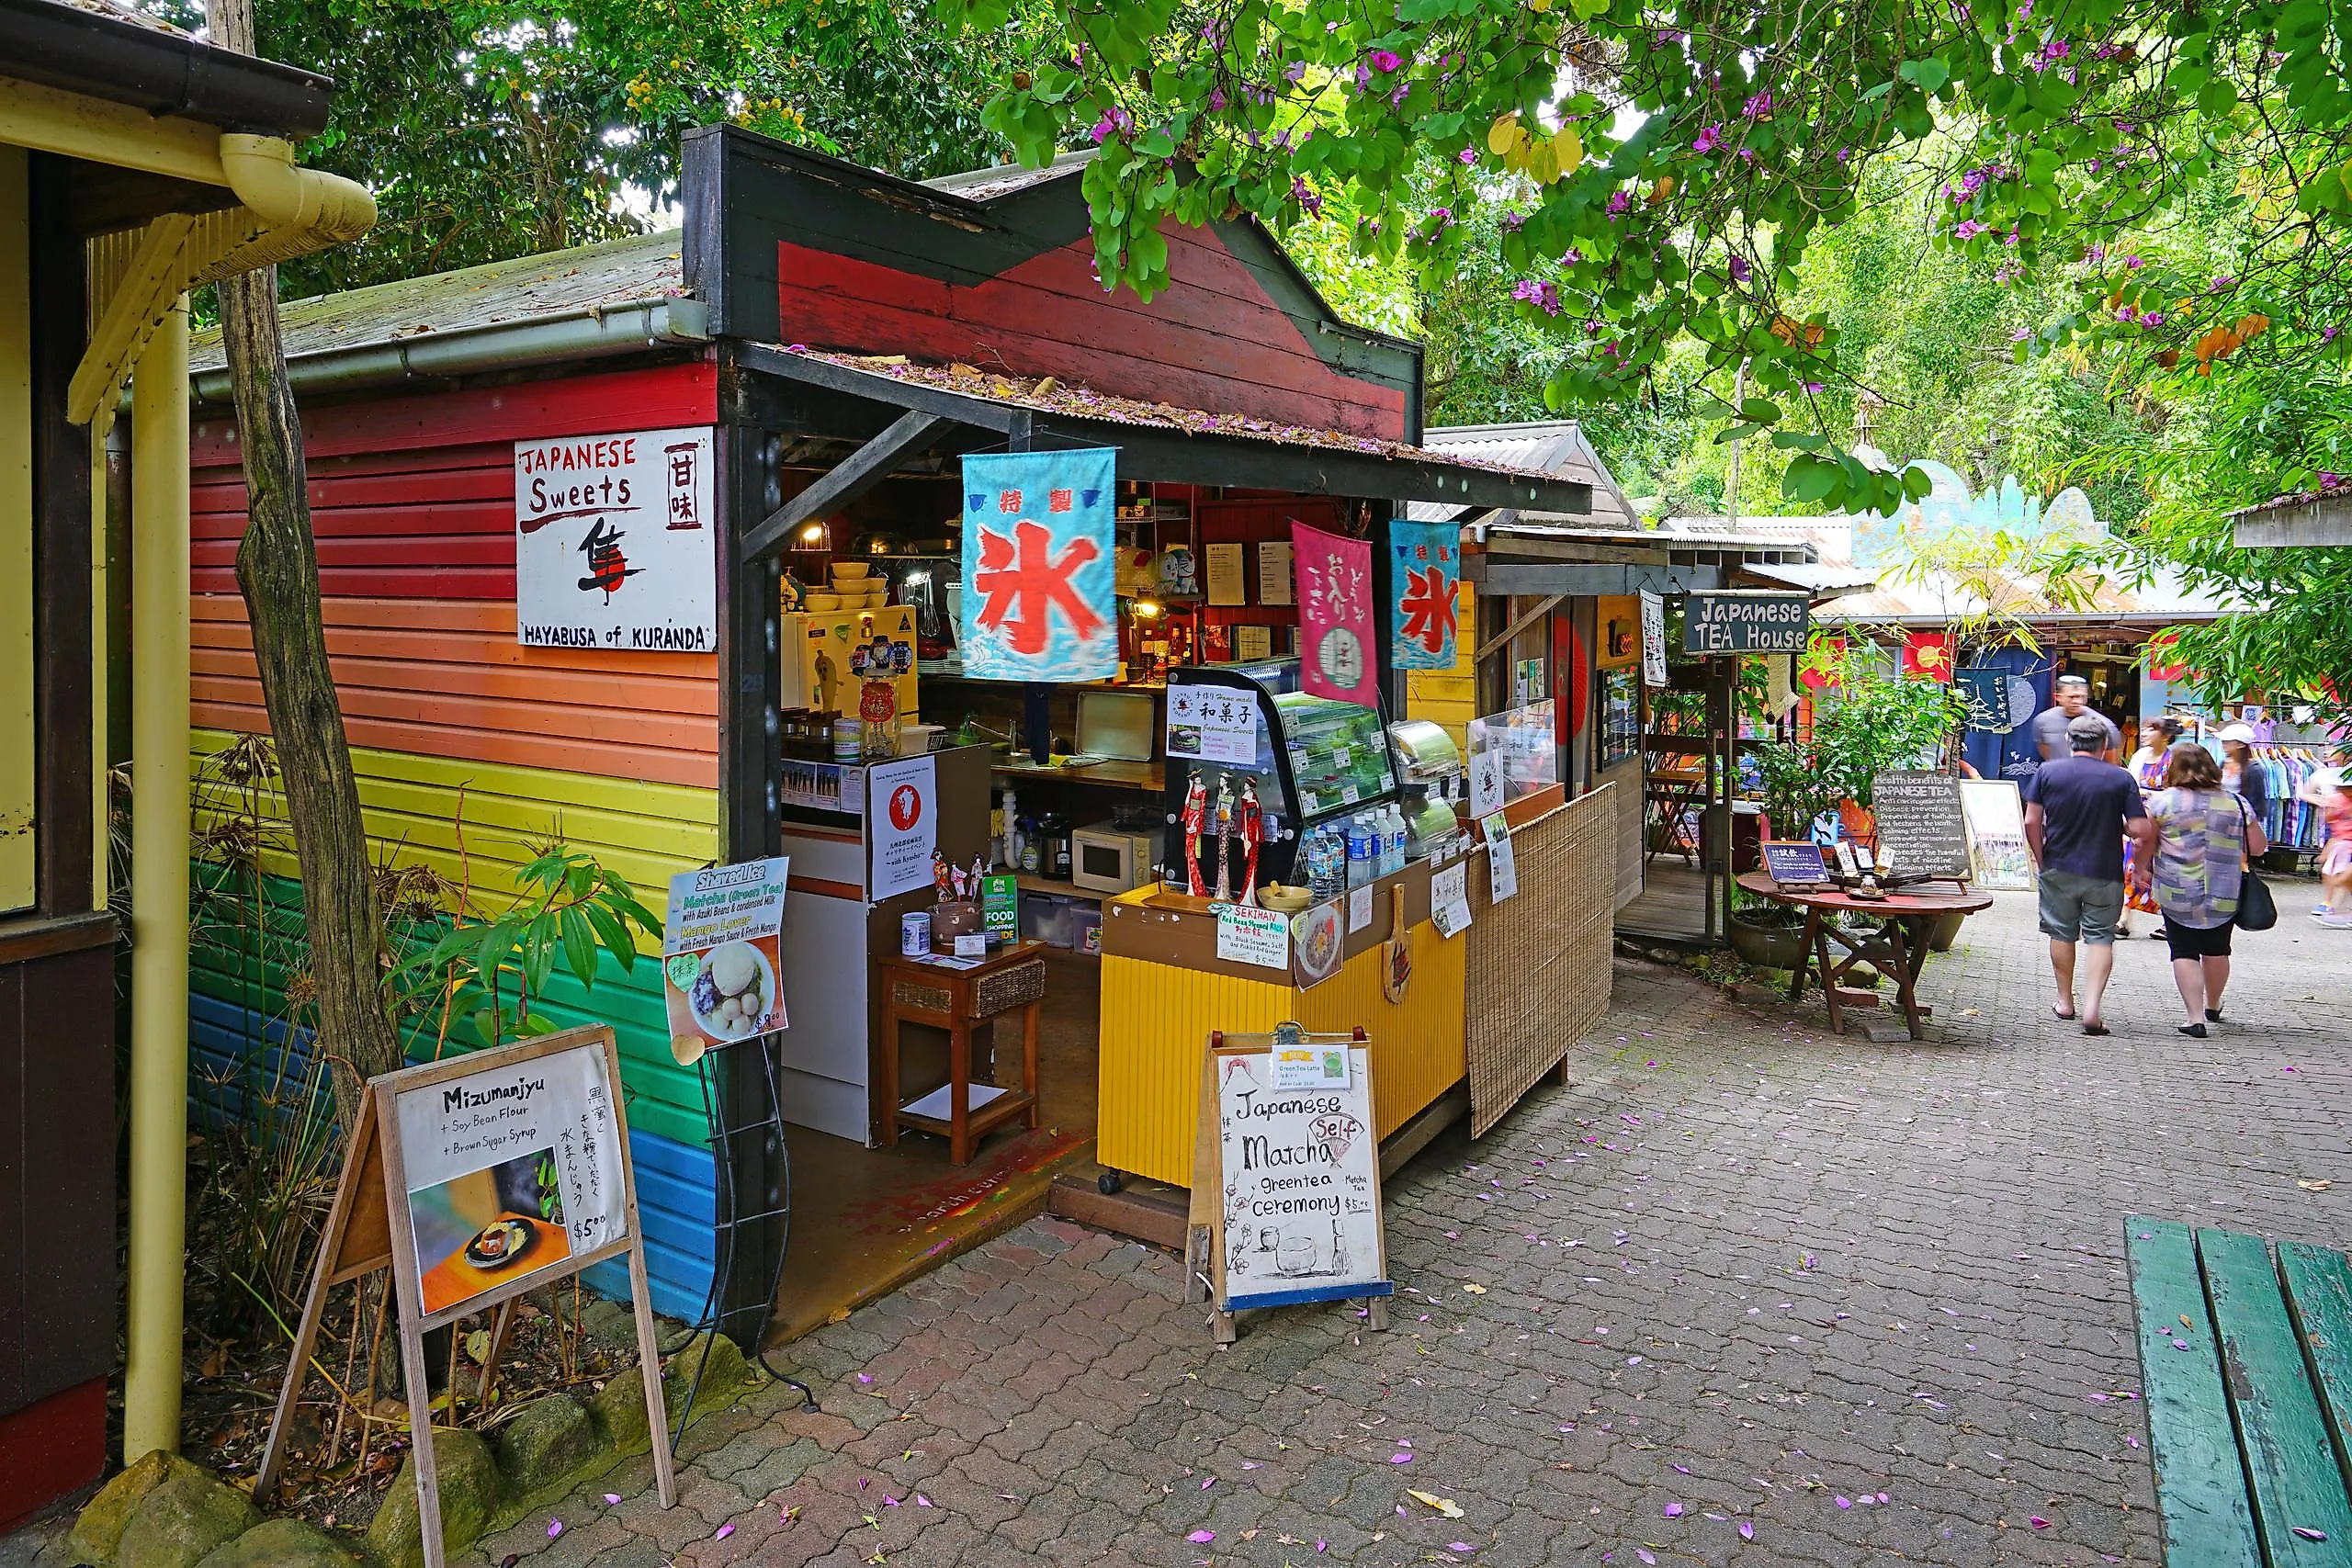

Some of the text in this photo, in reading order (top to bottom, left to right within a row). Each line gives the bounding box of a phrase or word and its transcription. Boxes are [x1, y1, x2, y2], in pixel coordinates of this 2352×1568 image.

[520, 438, 636, 474] JAPANESE
[529, 475, 631, 513] Sweets
[672, 456, 693, 520] 甘味
[1000, 489, 1073, 513] 特製
[976, 521, 1104, 655] 氷
[1400, 565, 1459, 653] 氷
[1701, 597, 1802, 624] Japanese
[524, 626, 706, 649] HAYABUSA of KURANDA
[1694, 623, 1806, 649] TEA House
[1199, 702, 1251, 724] 和菓子
[1874, 774, 1953, 784] Health benefits of
[1874, 785, 1952, 796] JAPANESE TEA
[697, 864, 766, 888] Shaved Ice
[684, 882, 784, 910] Matcha (Green Tea)
[683, 910, 695, 922] with
[713, 905, 730, 916] Beans
[986, 910, 1014, 923] FOOD
[1234, 907, 1277, 922] SEKIHAN
[681, 916, 752, 939] Mango Lover
[987, 923, 1014, 931] SHOPPING
[692, 938, 707, 949] Fresh
[709, 934, 726, 946] Mango
[726, 931, 741, 942] Sauce
[443, 1077, 544, 1114] Mizumanjyu
[1236, 1089, 1341, 1121] Japanese
[452, 1120, 471, 1133] Soy
[473, 1114, 497, 1127] Bean
[499, 1106, 529, 1121] Flour
[1222, 1116, 1231, 1144] 抹茶
[1316, 1119, 1357, 1140] Self
[453, 1141, 481, 1156] Brown
[509, 1126, 537, 1145] Syrup
[1242, 1129, 1334, 1171] Matcha
[560, 1127, 583, 1208] 水まんじゅう
[1345, 1175, 1367, 1185] Matcha
[1252, 1195, 1340, 1217] ceremony
